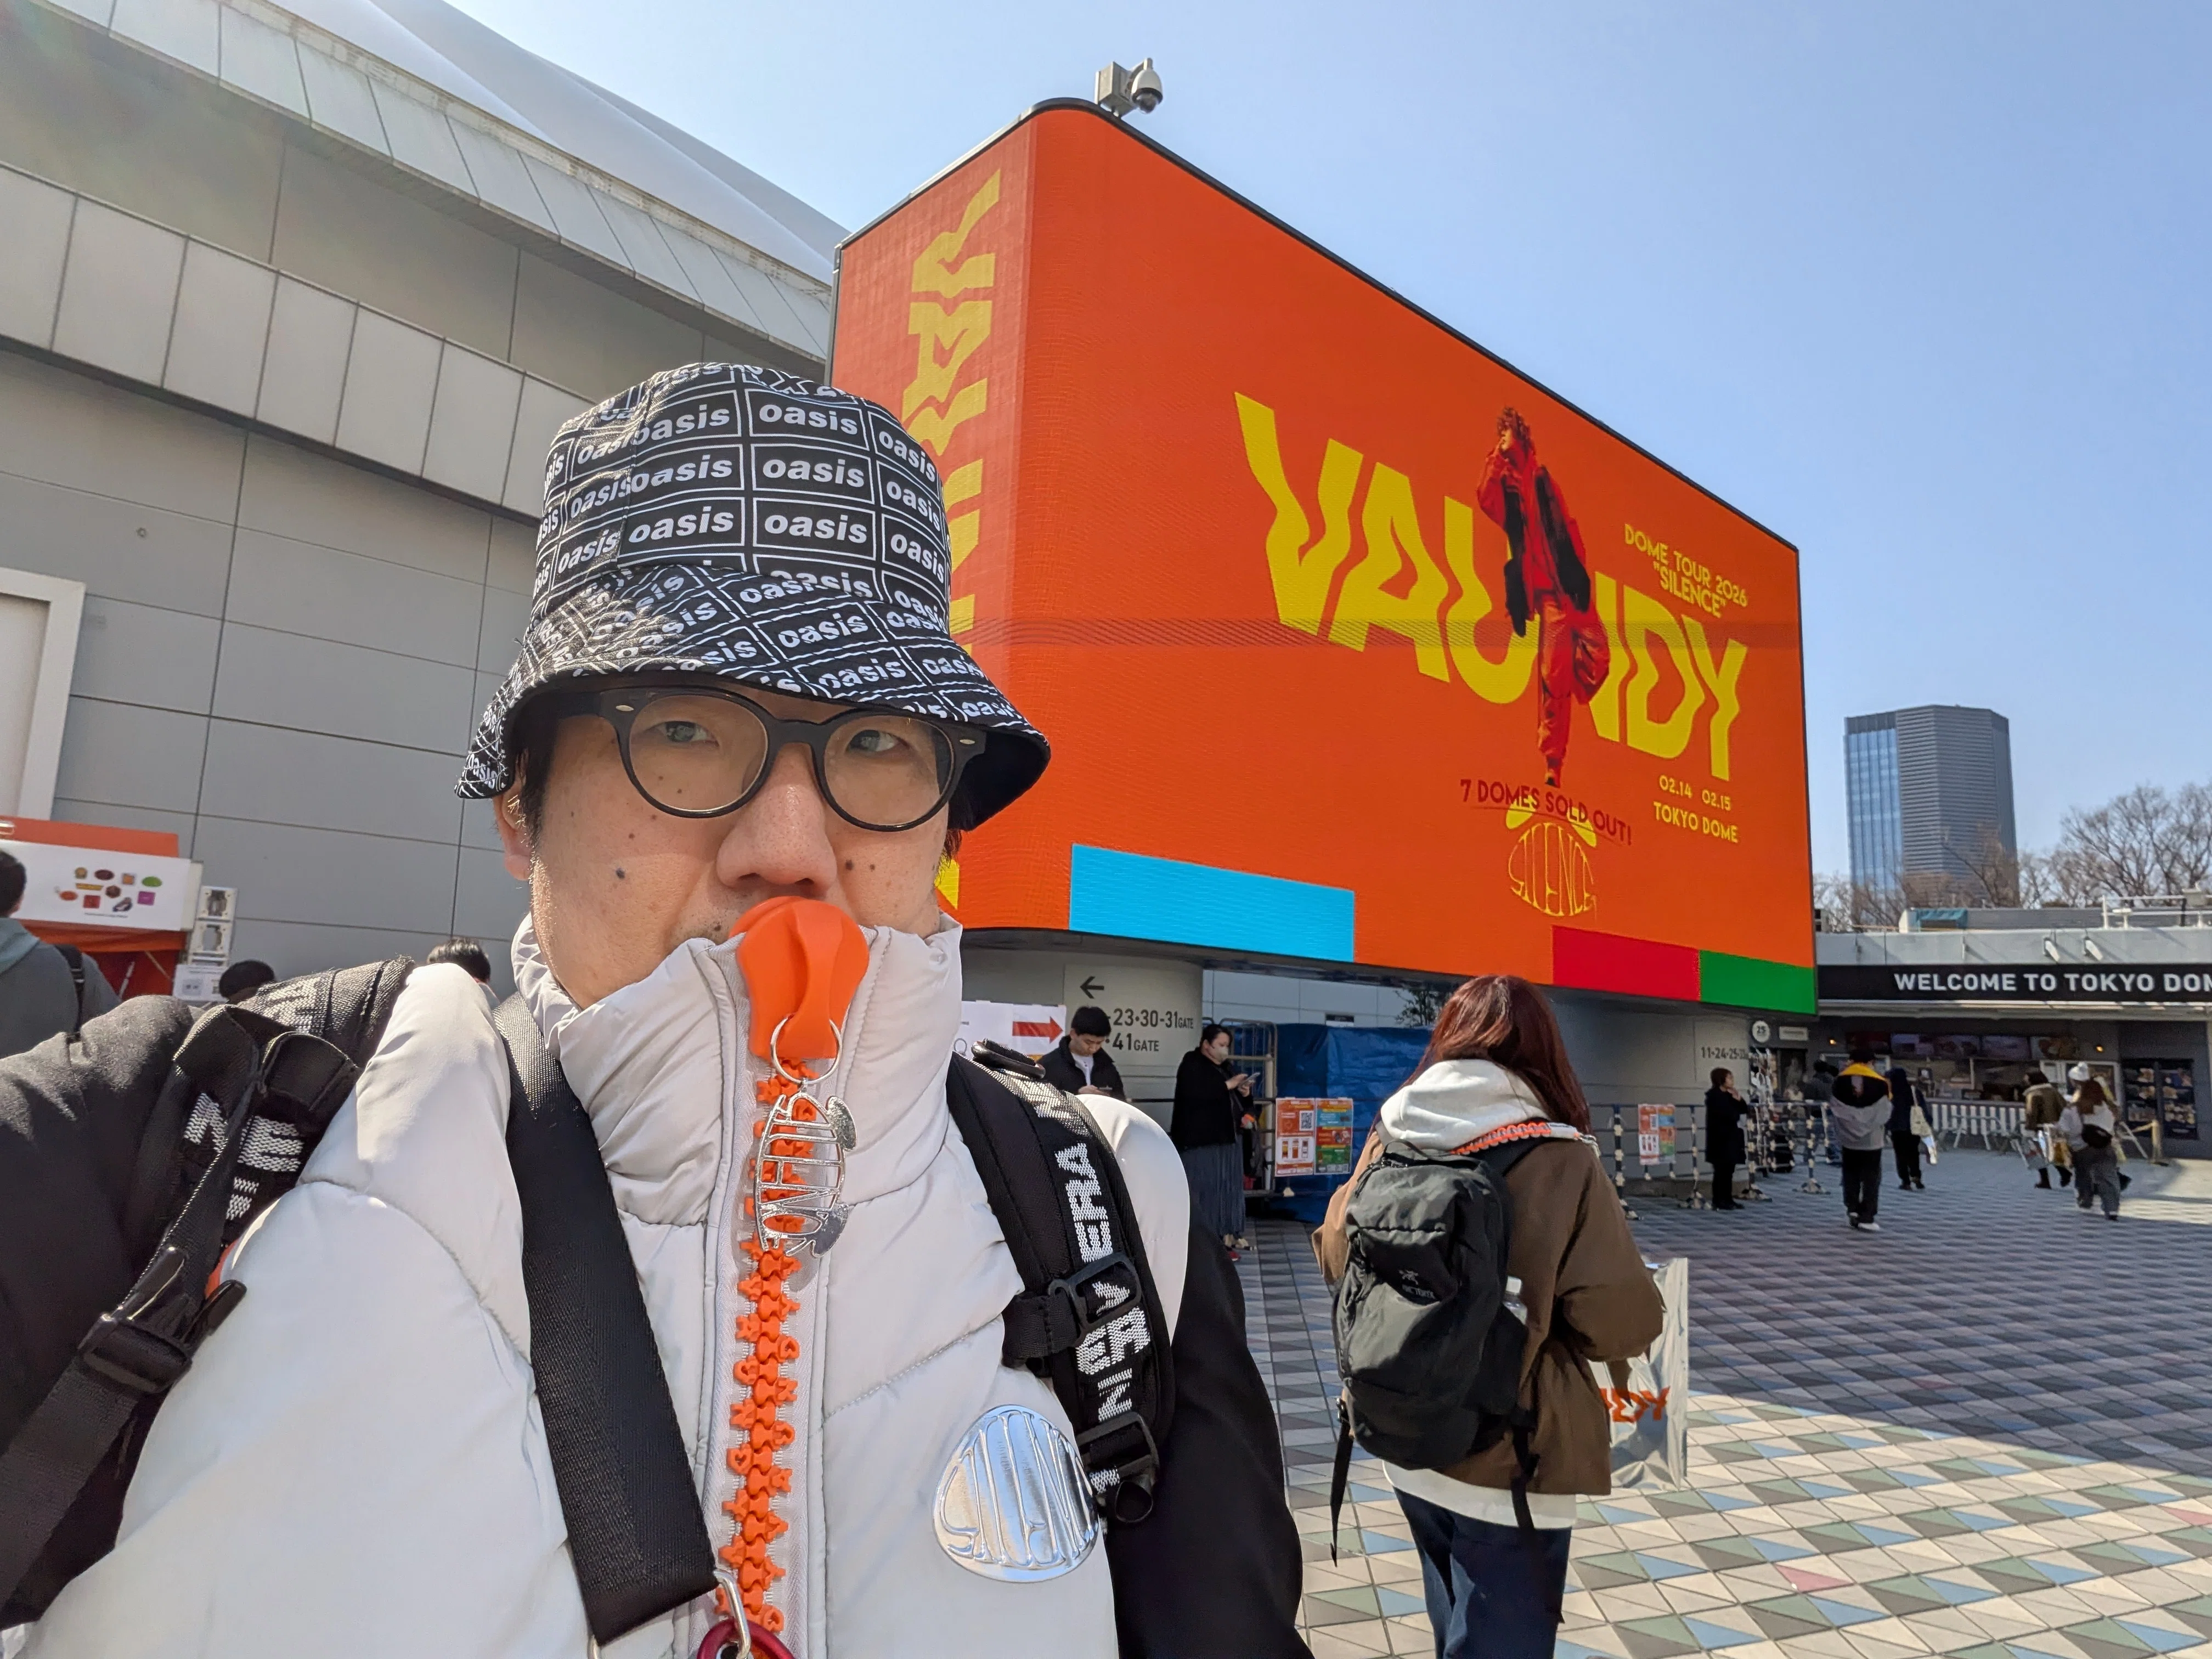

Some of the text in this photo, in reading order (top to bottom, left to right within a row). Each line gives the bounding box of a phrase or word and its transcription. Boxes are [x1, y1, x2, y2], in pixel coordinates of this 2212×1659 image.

[759, 404, 858, 436] oasis
[630, 454, 732, 493] oasis
[762, 459, 865, 488] oasis
[878, 431, 935, 483] oasis
[628, 506, 734, 544] oasis
[886, 480, 940, 532] oasis
[764, 515, 867, 544] oasis
[557, 529, 620, 574] oasis
[890, 533, 944, 583] oasis
[1624, 523, 1748, 607] DOME TOUR 2026
[778, 612, 868, 648] oasis
[819, 658, 906, 689] oasis
[1659, 774, 1731, 811] 02.14 02.15
[1460, 779, 1632, 846] 7 DOMES SOLD OUT!
[1654, 801, 1739, 843] TOKYO DOME
[1894, 973, 2017, 991] WELCOME
[2024, 973, 2057, 991] TO
[2063, 973, 2154, 992] TOKYO
